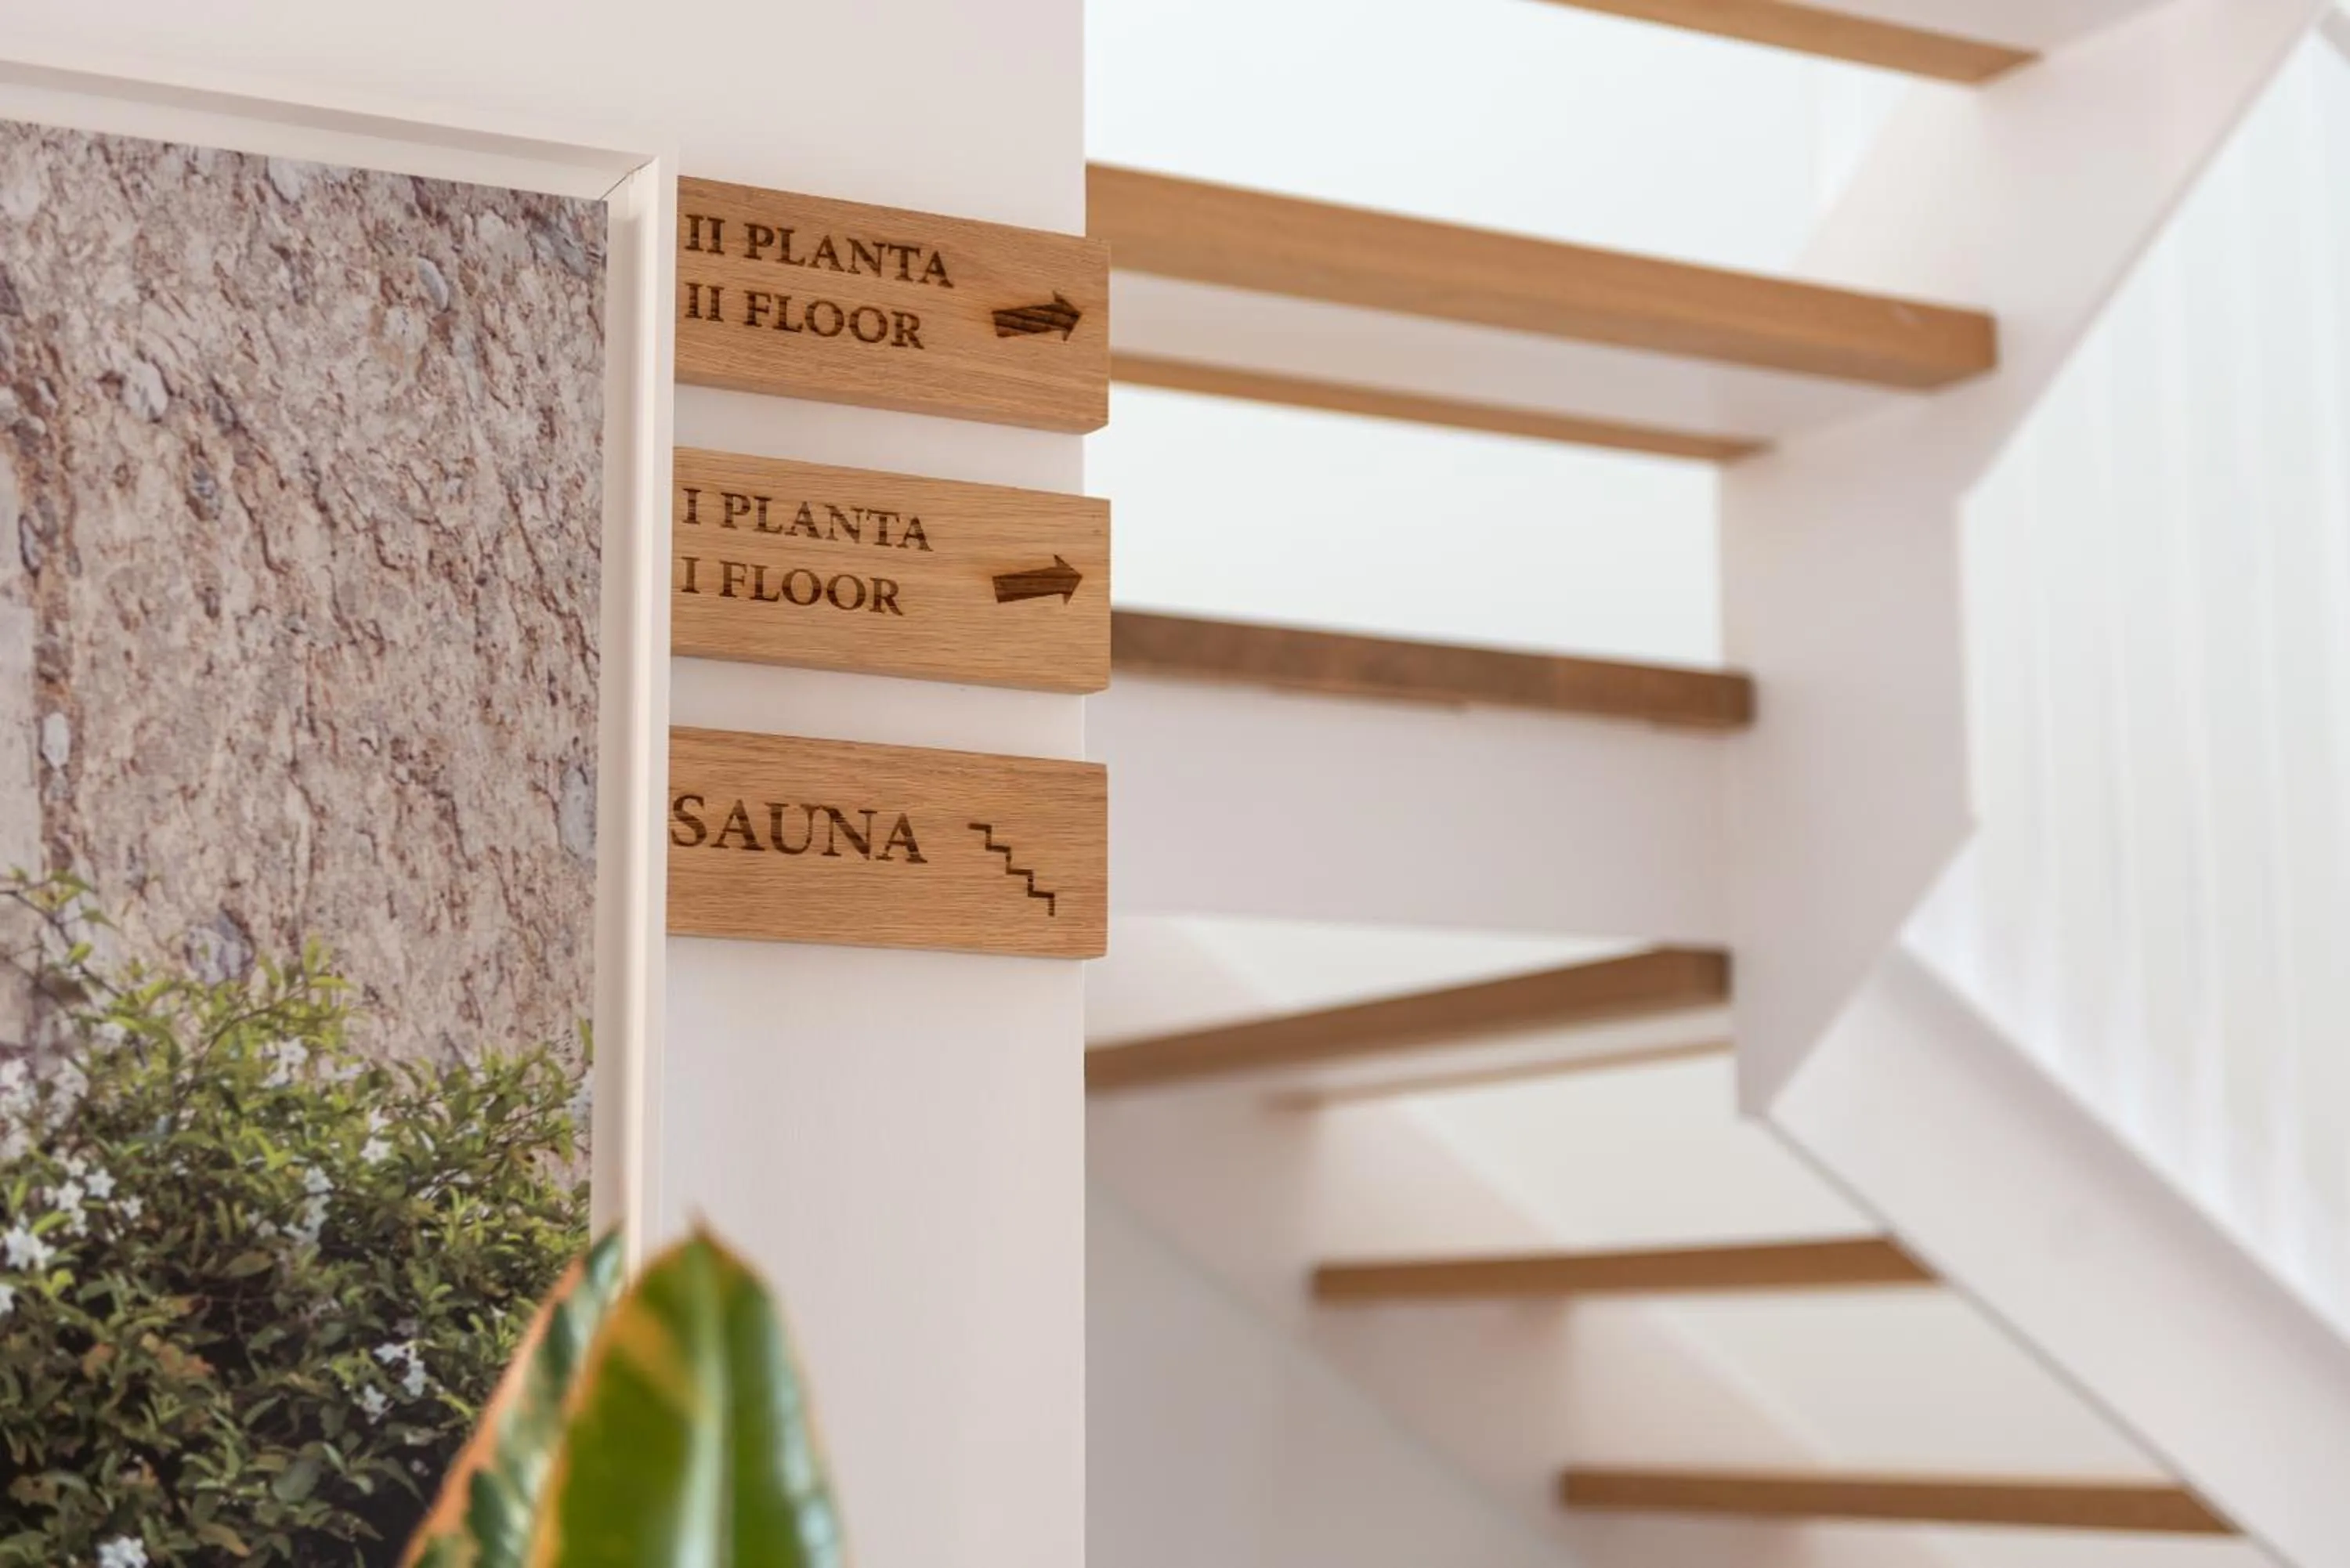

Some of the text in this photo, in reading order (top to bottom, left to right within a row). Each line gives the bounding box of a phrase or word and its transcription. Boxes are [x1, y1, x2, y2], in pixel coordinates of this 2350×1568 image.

[685, 214, 954, 288] II PLANTA
[685, 282, 924, 349] II FLOOR
[682, 488, 933, 551] I PLANTA
[681, 556, 903, 616] I FLOOR
[670, 794, 928, 863] SAUNA
